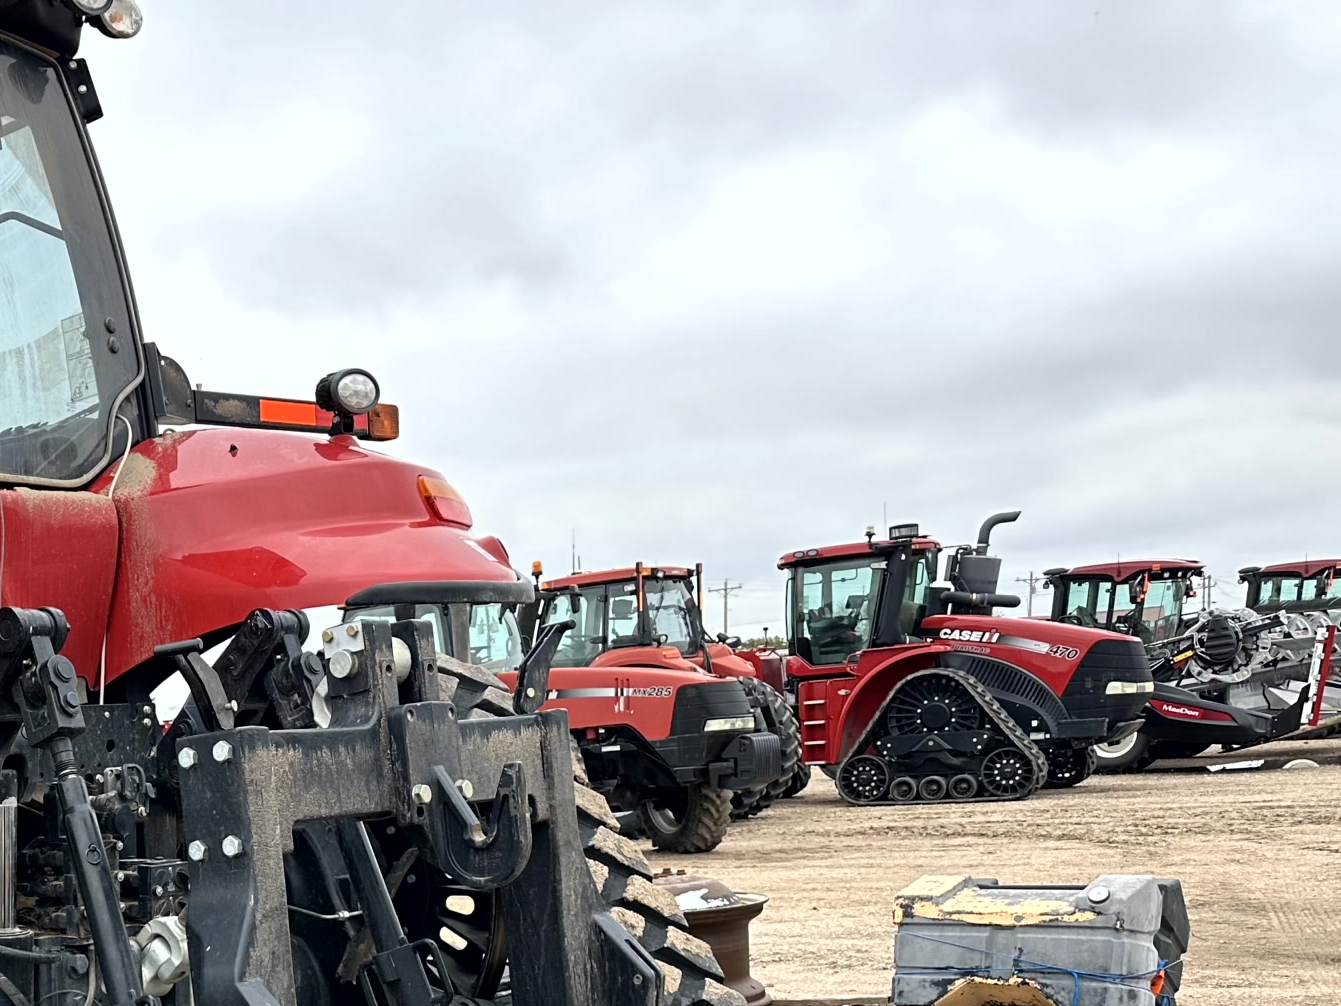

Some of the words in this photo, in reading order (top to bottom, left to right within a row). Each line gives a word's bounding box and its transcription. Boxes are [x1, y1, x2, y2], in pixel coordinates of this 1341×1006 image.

[939, 628, 983, 642] CASE
[1049, 645, 1080, 660] 470
[631, 686, 673, 697] MX285
[1162, 704, 1199, 716] MacDon
